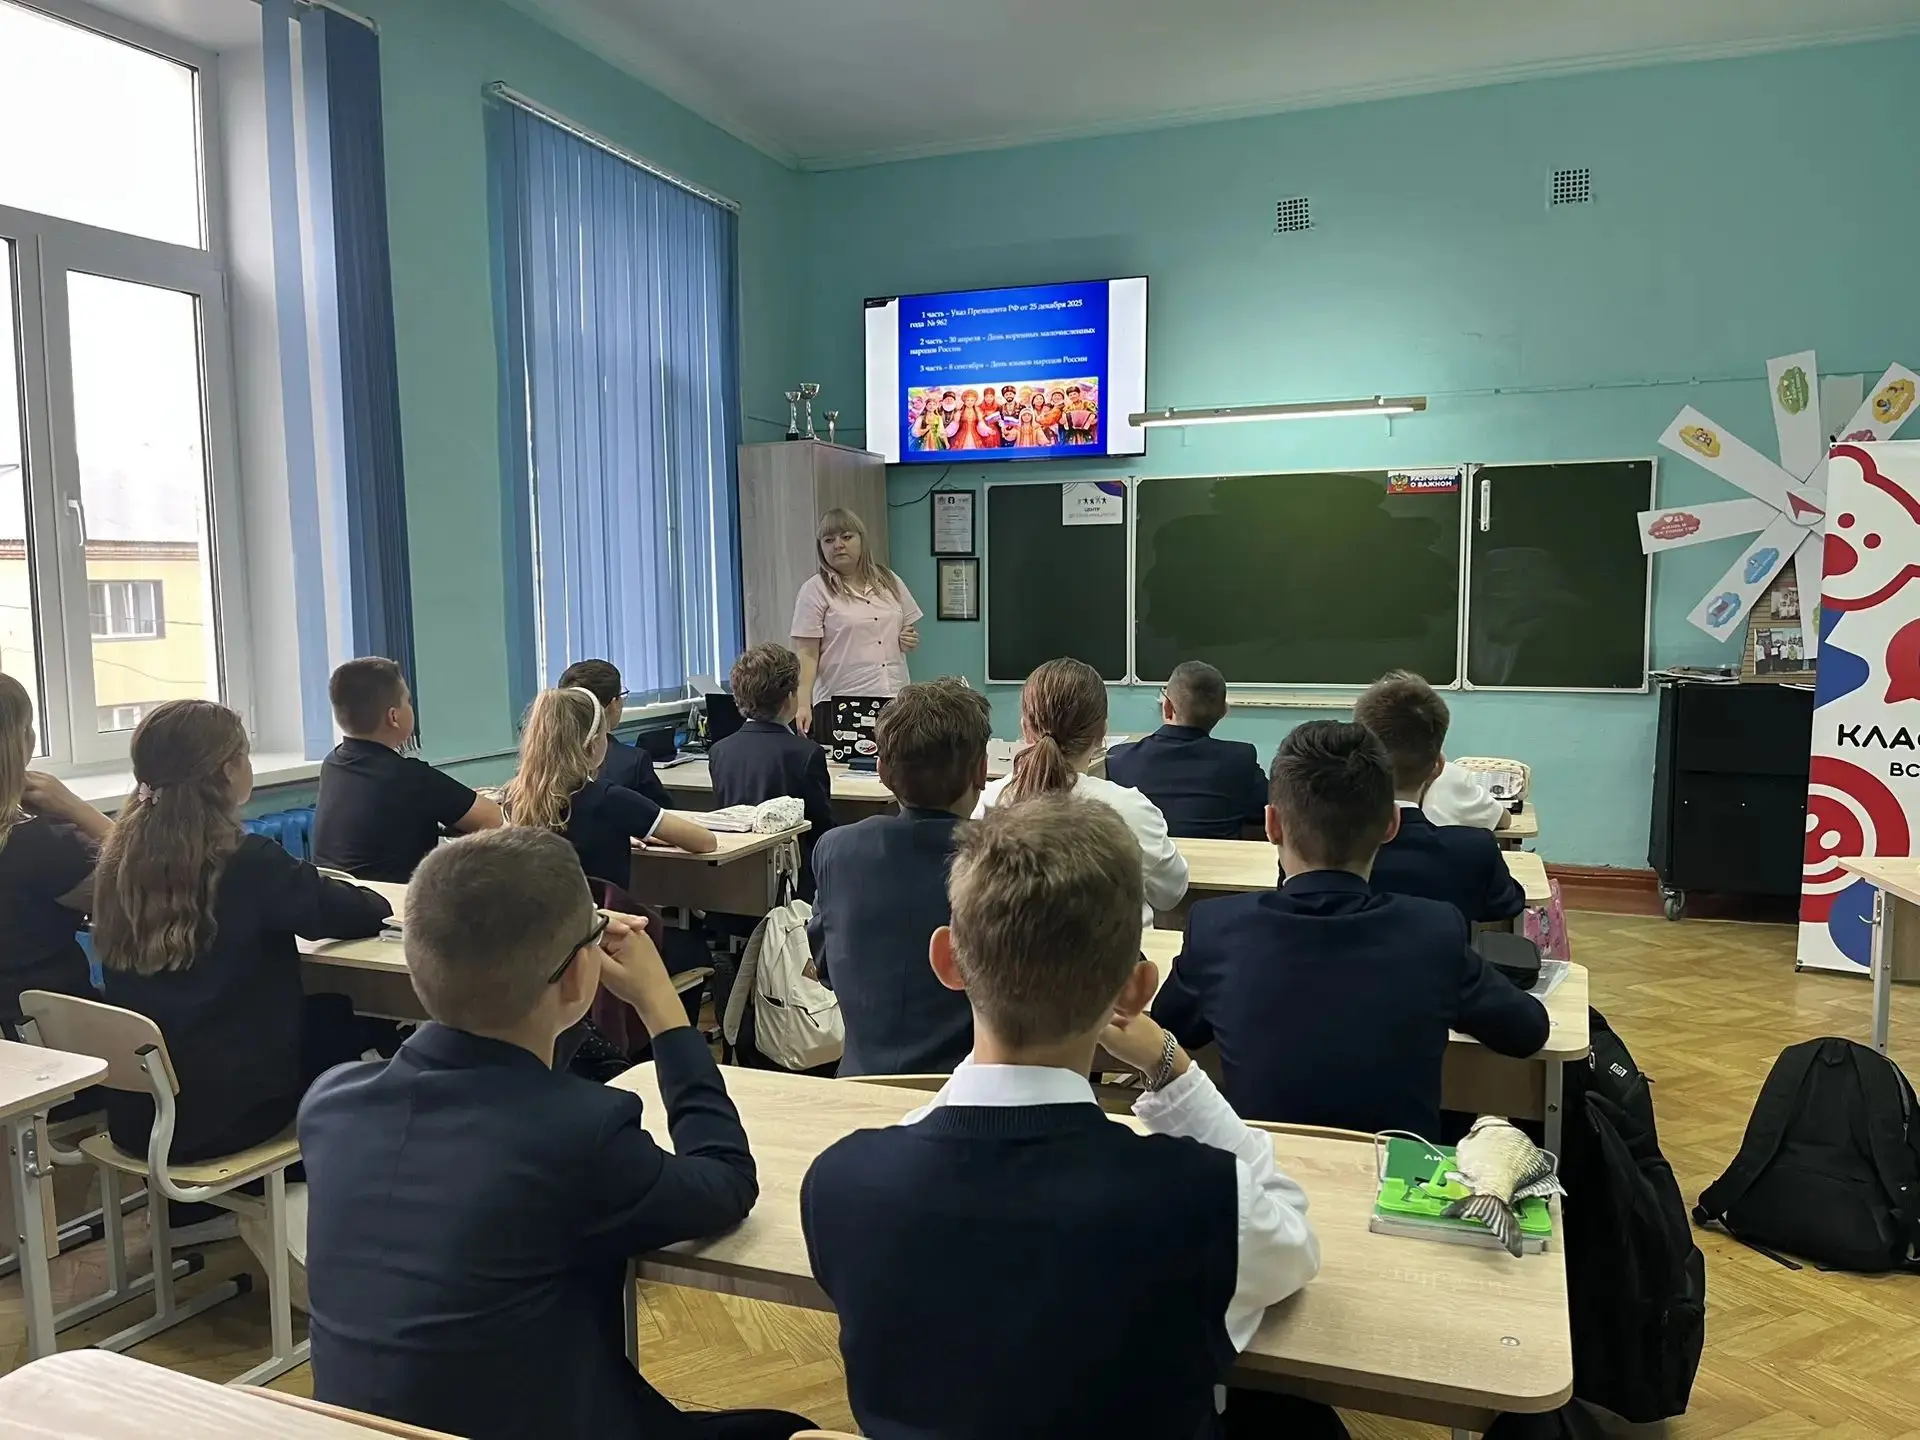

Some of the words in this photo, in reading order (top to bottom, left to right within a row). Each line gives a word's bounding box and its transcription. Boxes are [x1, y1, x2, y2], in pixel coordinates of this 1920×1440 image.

[951, 308, 966, 317] Указ
[967, 305, 1007, 316] Президента
[1008, 304, 1019, 312] РФ
[1037, 301, 1066, 310] декабря
[1067, 299, 1083, 307] 2025
[927, 319, 935, 327] №
[957, 335, 981, 344] апреля
[987, 332, 1005, 341] День
[1005, 331, 1039, 340] коренных
[909, 347, 937, 356] народов
[938, 345, 962, 353] России
[1063, 356, 1088, 364] России
[1417, 480, 1452, 488] ВАЖНОМ
[1837, 723, 1920, 751] КЛА
